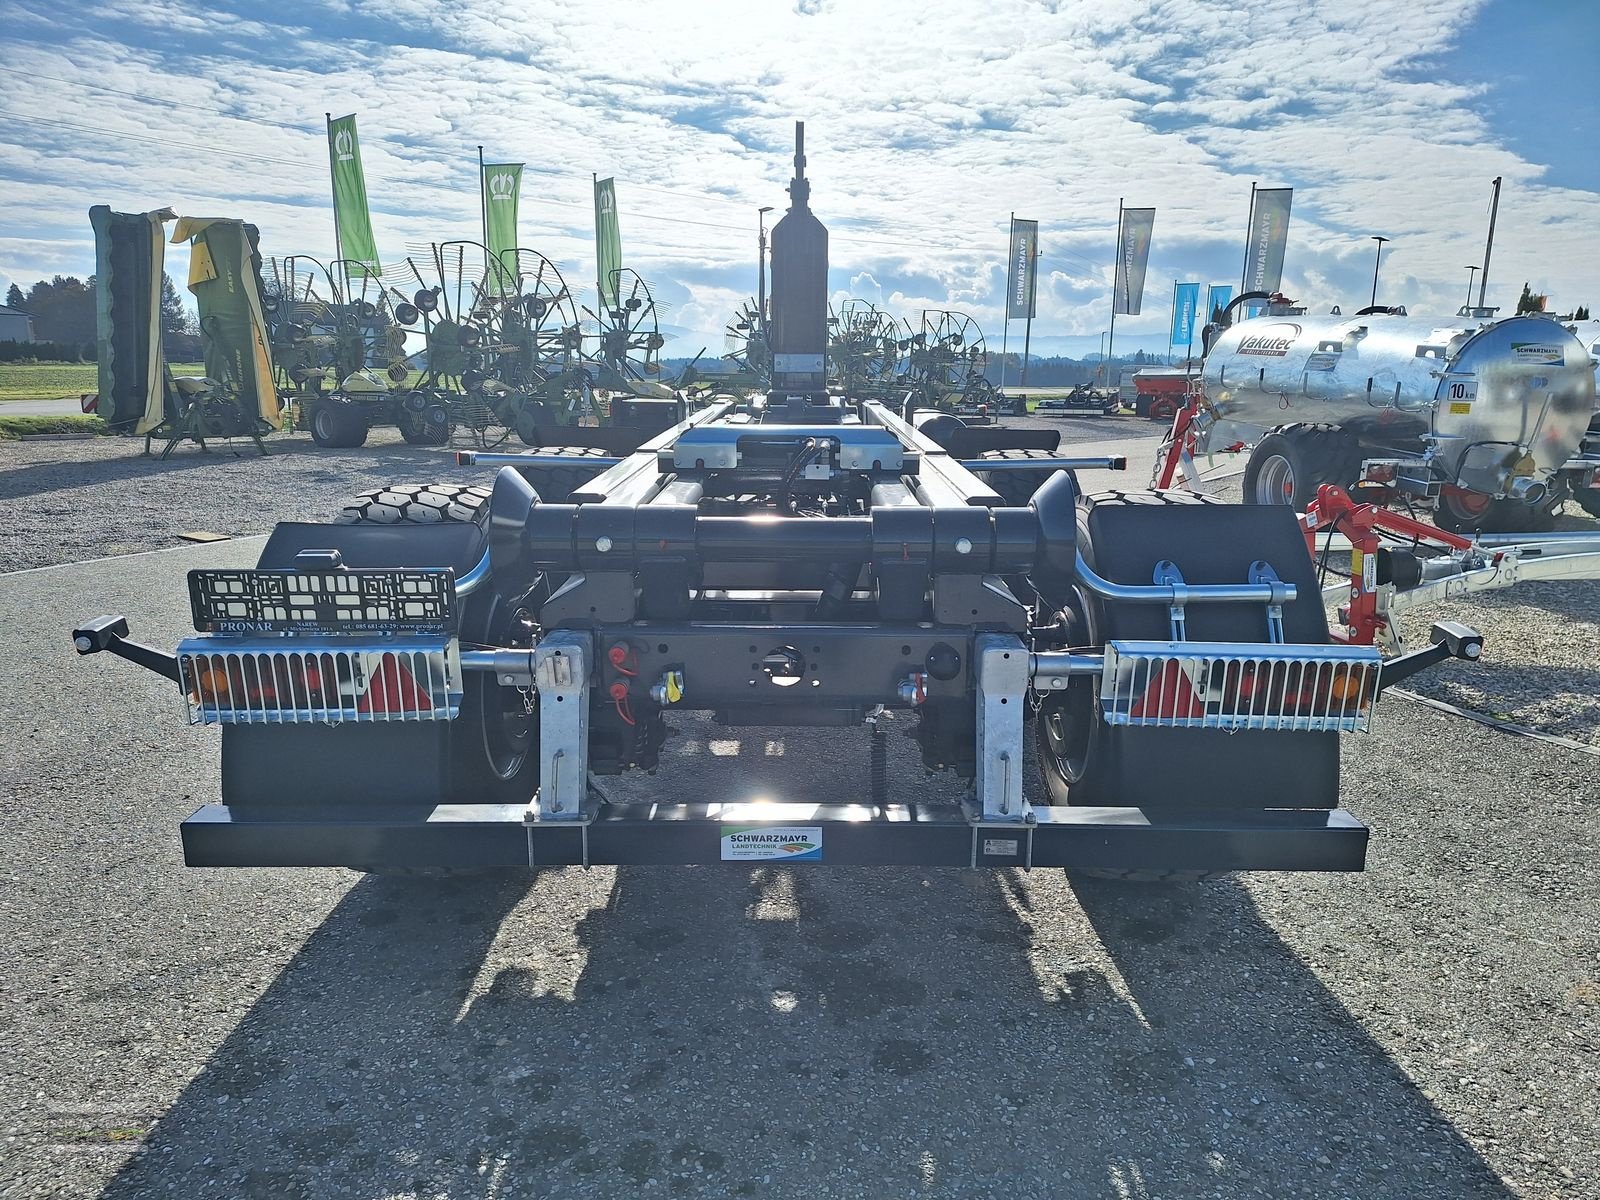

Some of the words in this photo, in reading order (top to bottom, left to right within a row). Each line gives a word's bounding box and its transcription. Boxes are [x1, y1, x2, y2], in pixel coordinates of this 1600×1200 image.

[1254, 212, 1271, 292] SCHWARZMAYR
[1017, 238, 1026, 306] SCHWARZMAYR
[1124, 227, 1136, 300] SARZMAYR
[1236, 335, 1296, 354] Vakutec
[1451, 383, 1465, 399] 10
[1465, 391, 1475, 399] km
[219, 622, 273, 632] PRONAR
[730, 834, 808, 842] SCHWARZMAYR
